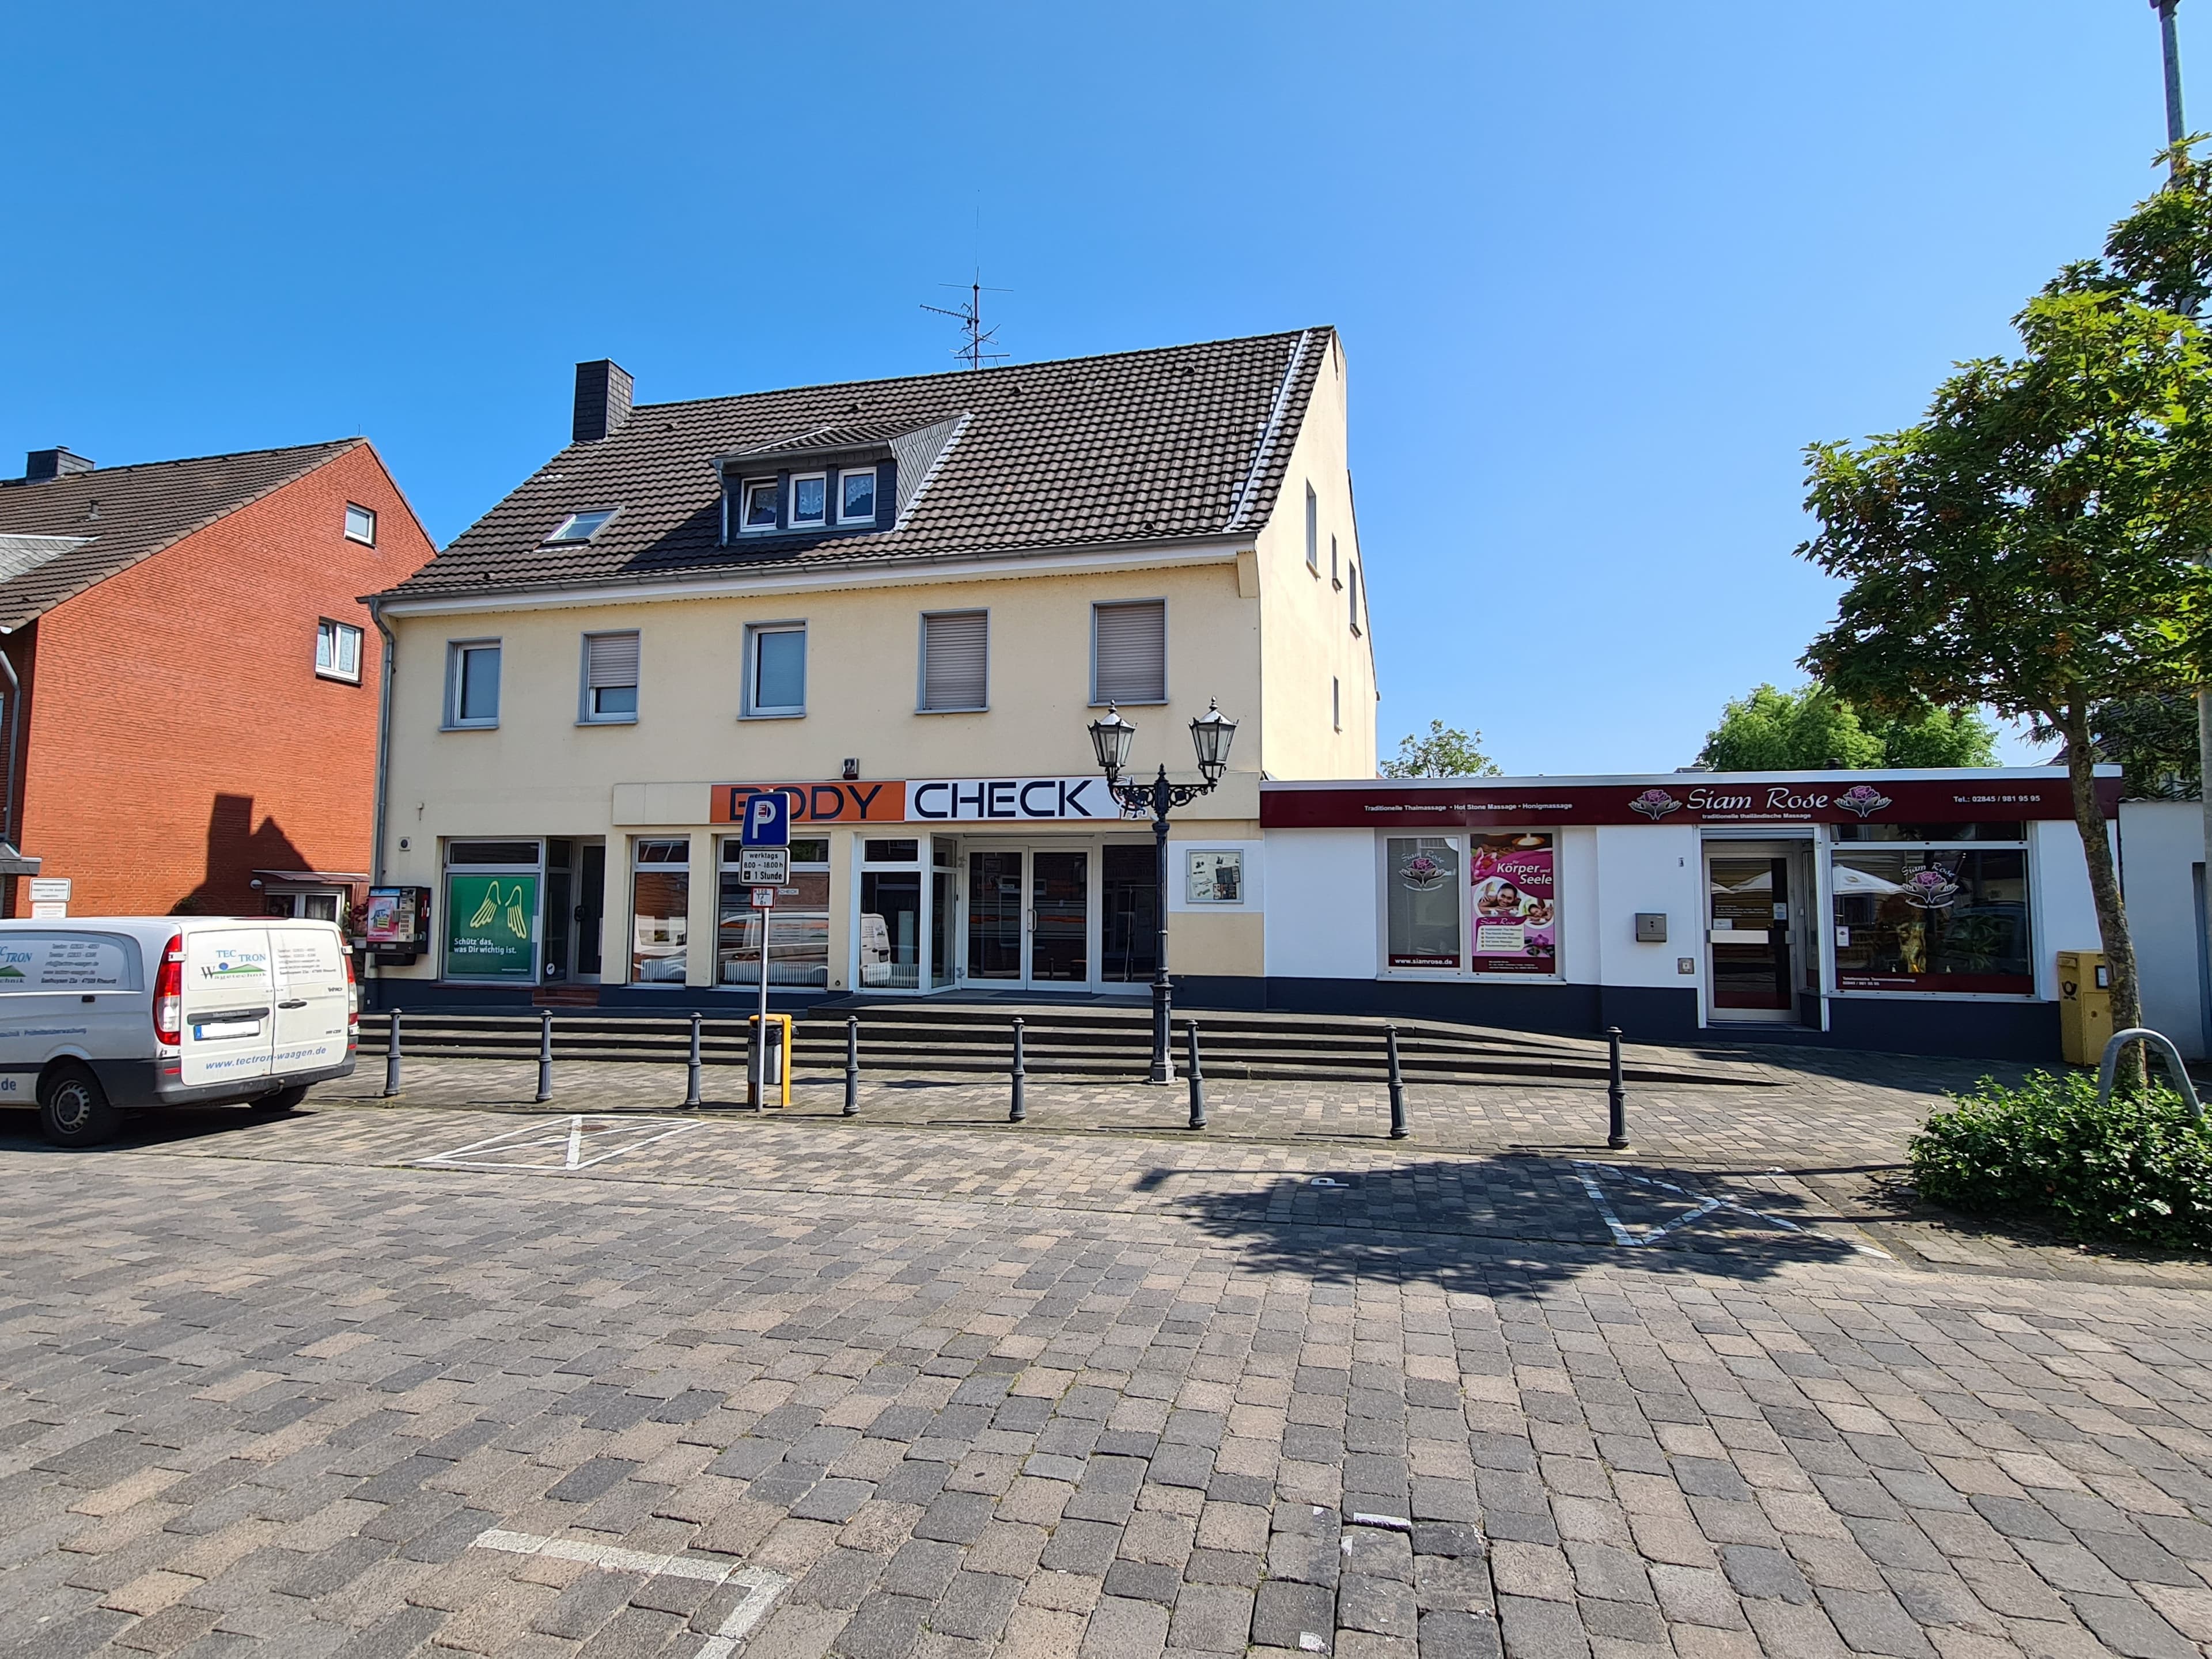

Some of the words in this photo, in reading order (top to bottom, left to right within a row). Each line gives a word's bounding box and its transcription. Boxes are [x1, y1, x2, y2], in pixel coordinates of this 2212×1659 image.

[914, 780, 1092, 819] CHECK
[1687, 788, 1752, 809] Siam
[1766, 787, 1828, 809] Rose
[752, 801, 777, 839] P
[1402, 853, 1421, 862] Siam
[1425, 850, 1445, 863] Rose
[1497, 863, 1540, 875] Körper
[1901, 864, 1927, 876] Siam
[1931, 862, 1956, 878] Rose
[755, 872, 757, 880] 1
[760, 871, 782, 880] Stunde
[1520, 874, 1552, 884] Seele
[216, 950, 237, 958] TEC
[479, 946, 505, 955] wichtig
[6, 952, 33, 963] TRON
[238, 953, 266, 962] TRON
[205, 1046, 327, 1070] www.tectron-waagen.de
